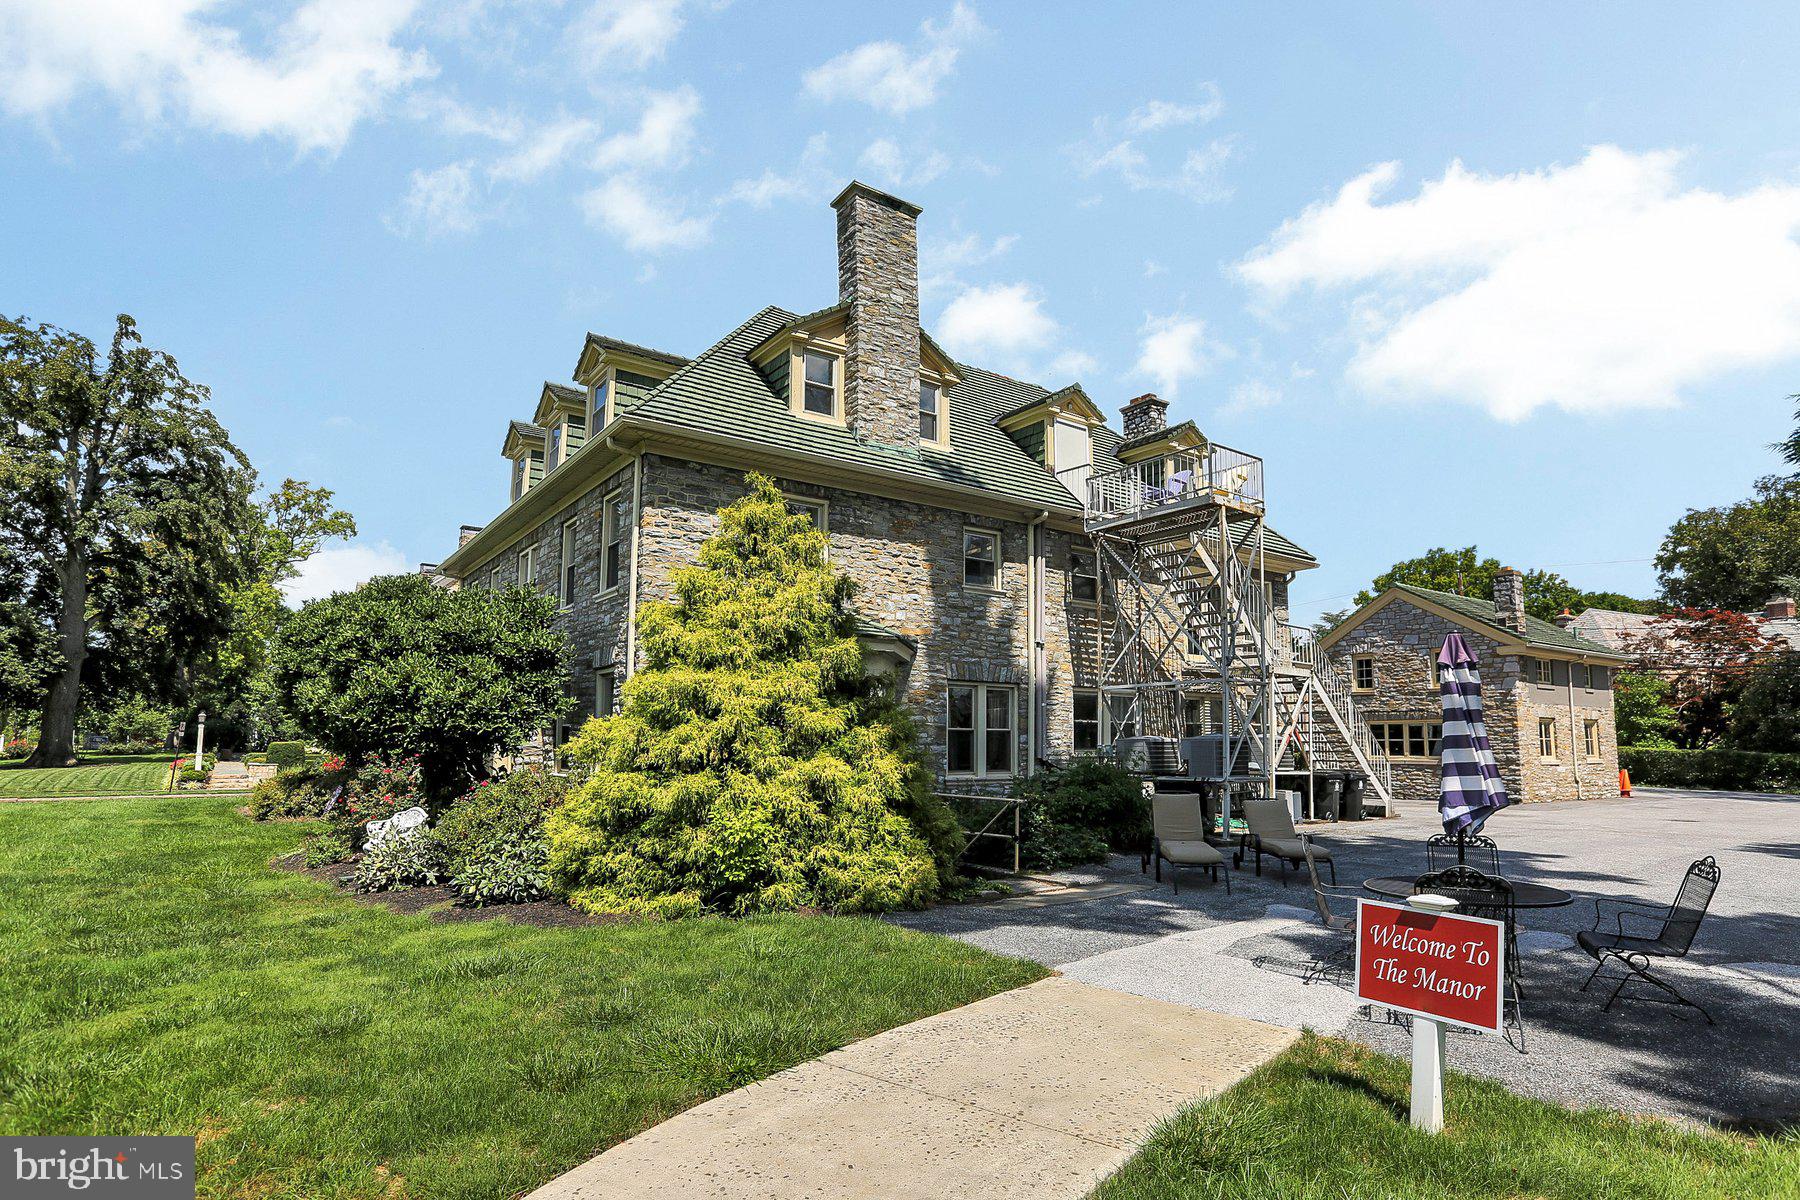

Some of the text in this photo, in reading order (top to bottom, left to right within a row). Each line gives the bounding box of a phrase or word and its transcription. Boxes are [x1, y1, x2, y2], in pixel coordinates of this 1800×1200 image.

[1370, 924, 1490, 967] Welcome To
[1373, 958, 1487, 1001] The Manor
